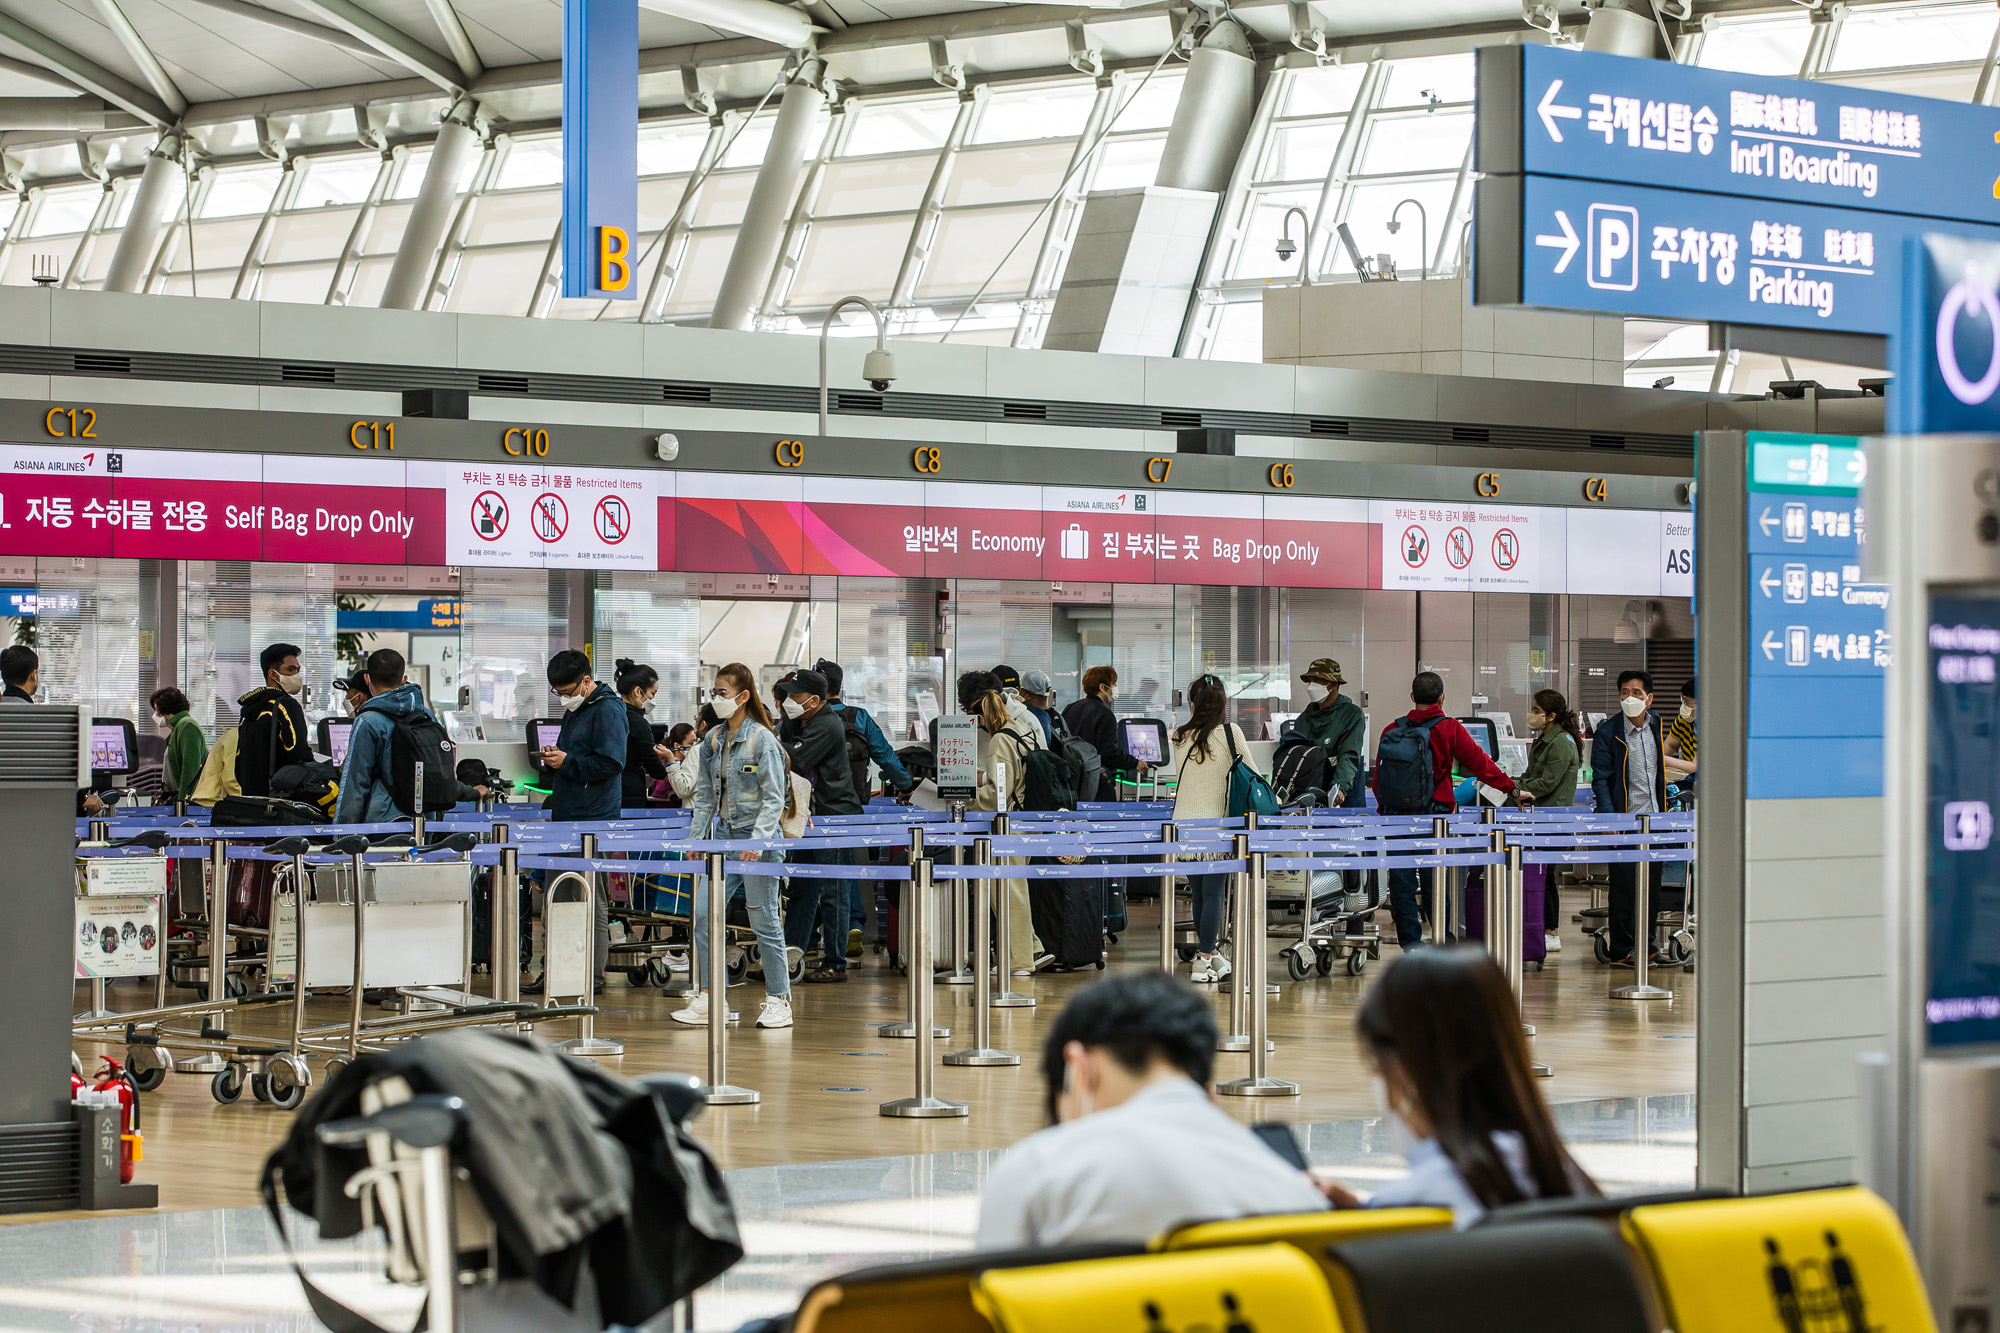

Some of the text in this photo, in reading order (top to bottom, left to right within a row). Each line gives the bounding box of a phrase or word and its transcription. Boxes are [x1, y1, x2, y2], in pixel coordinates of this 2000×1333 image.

[1588, 94, 1718, 155] 국제선탑승
[1731, 139, 1877, 198] Int'l Boarding
[601, 226, 630, 291] B
[1600, 218, 1629, 278] P
[1651, 226, 1738, 285] 주차장
[1750, 267, 1833, 317] Parking
[46, 408, 97, 438] C12
[351, 421, 394, 450] C11
[504, 428, 549, 456] C10
[776, 440, 804, 467] C9
[14, 460, 85, 471] ASIANA AIRLINES
[914, 447, 941, 473] C8
[1148, 458, 1173, 482] C7
[462, 472, 642, 489] 부치는 짐 탁송 금지 물품 Restricted Items
[1271, 464, 1294, 488] C6
[1478, 473, 1500, 497] C5
[1586, 478, 1608, 501] C4
[25, 496, 414, 539] 자동 수하물 전용 Self Bag Drop Only
[1067, 500, 1119, 510] ASIANA AIRLINES
[1395, 509, 1528, 523] 부치는 짐 탁송 금지 물품 Restricted Items
[903, 525, 1045, 557] 일반석 Economy
[1666, 523, 1691, 536] Better
[1102, 532, 1319, 565] 짐 부치는 곳 Bag Drop Only
[940, 738, 973, 746] バッテリー、
[102, 1118, 114, 1169] 소화기
